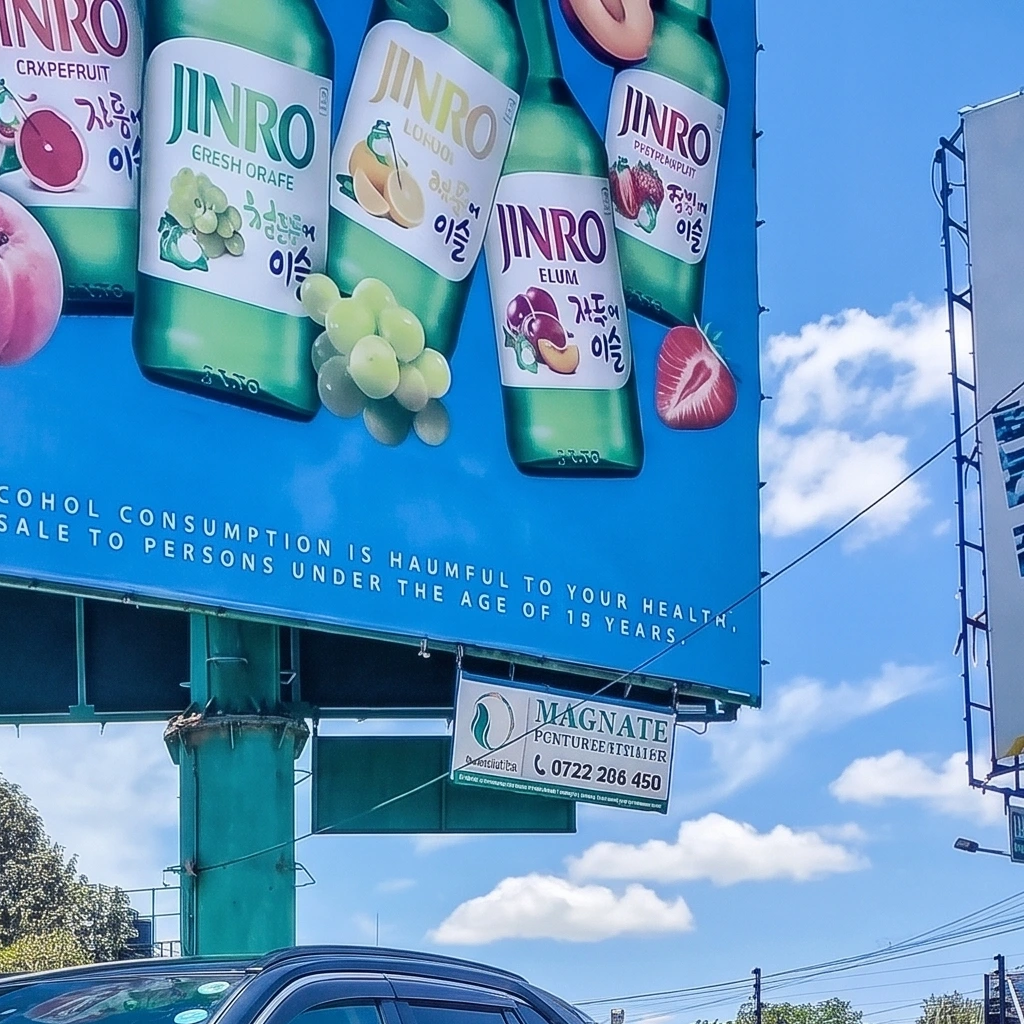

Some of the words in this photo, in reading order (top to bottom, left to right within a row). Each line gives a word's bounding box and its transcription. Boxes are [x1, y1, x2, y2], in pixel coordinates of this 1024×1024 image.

[166, 63, 315, 169] JINRO
[369, 40, 497, 160] JINRO
[617, 85, 711, 166] JINRO
[496, 203, 606, 274] JINRO
[89, 528, 124, 550] TO
[144, 537, 274, 575] PERSONS
[292, 562, 381, 592] UNDER
[398, 579, 443, 602] THE
[461, 591, 507, 613] AGE
[522, 602, 550, 621] OF
[119, 505, 331, 557] CONSUMPTION
[349, 544, 371, 563] IS
[524, 576, 552, 595] TO
[567, 584, 627, 610] YOUR
[535, 699, 668, 743] MAGNATE
[551, 759, 593, 781] 0722
[631, 772, 662, 791] 450
